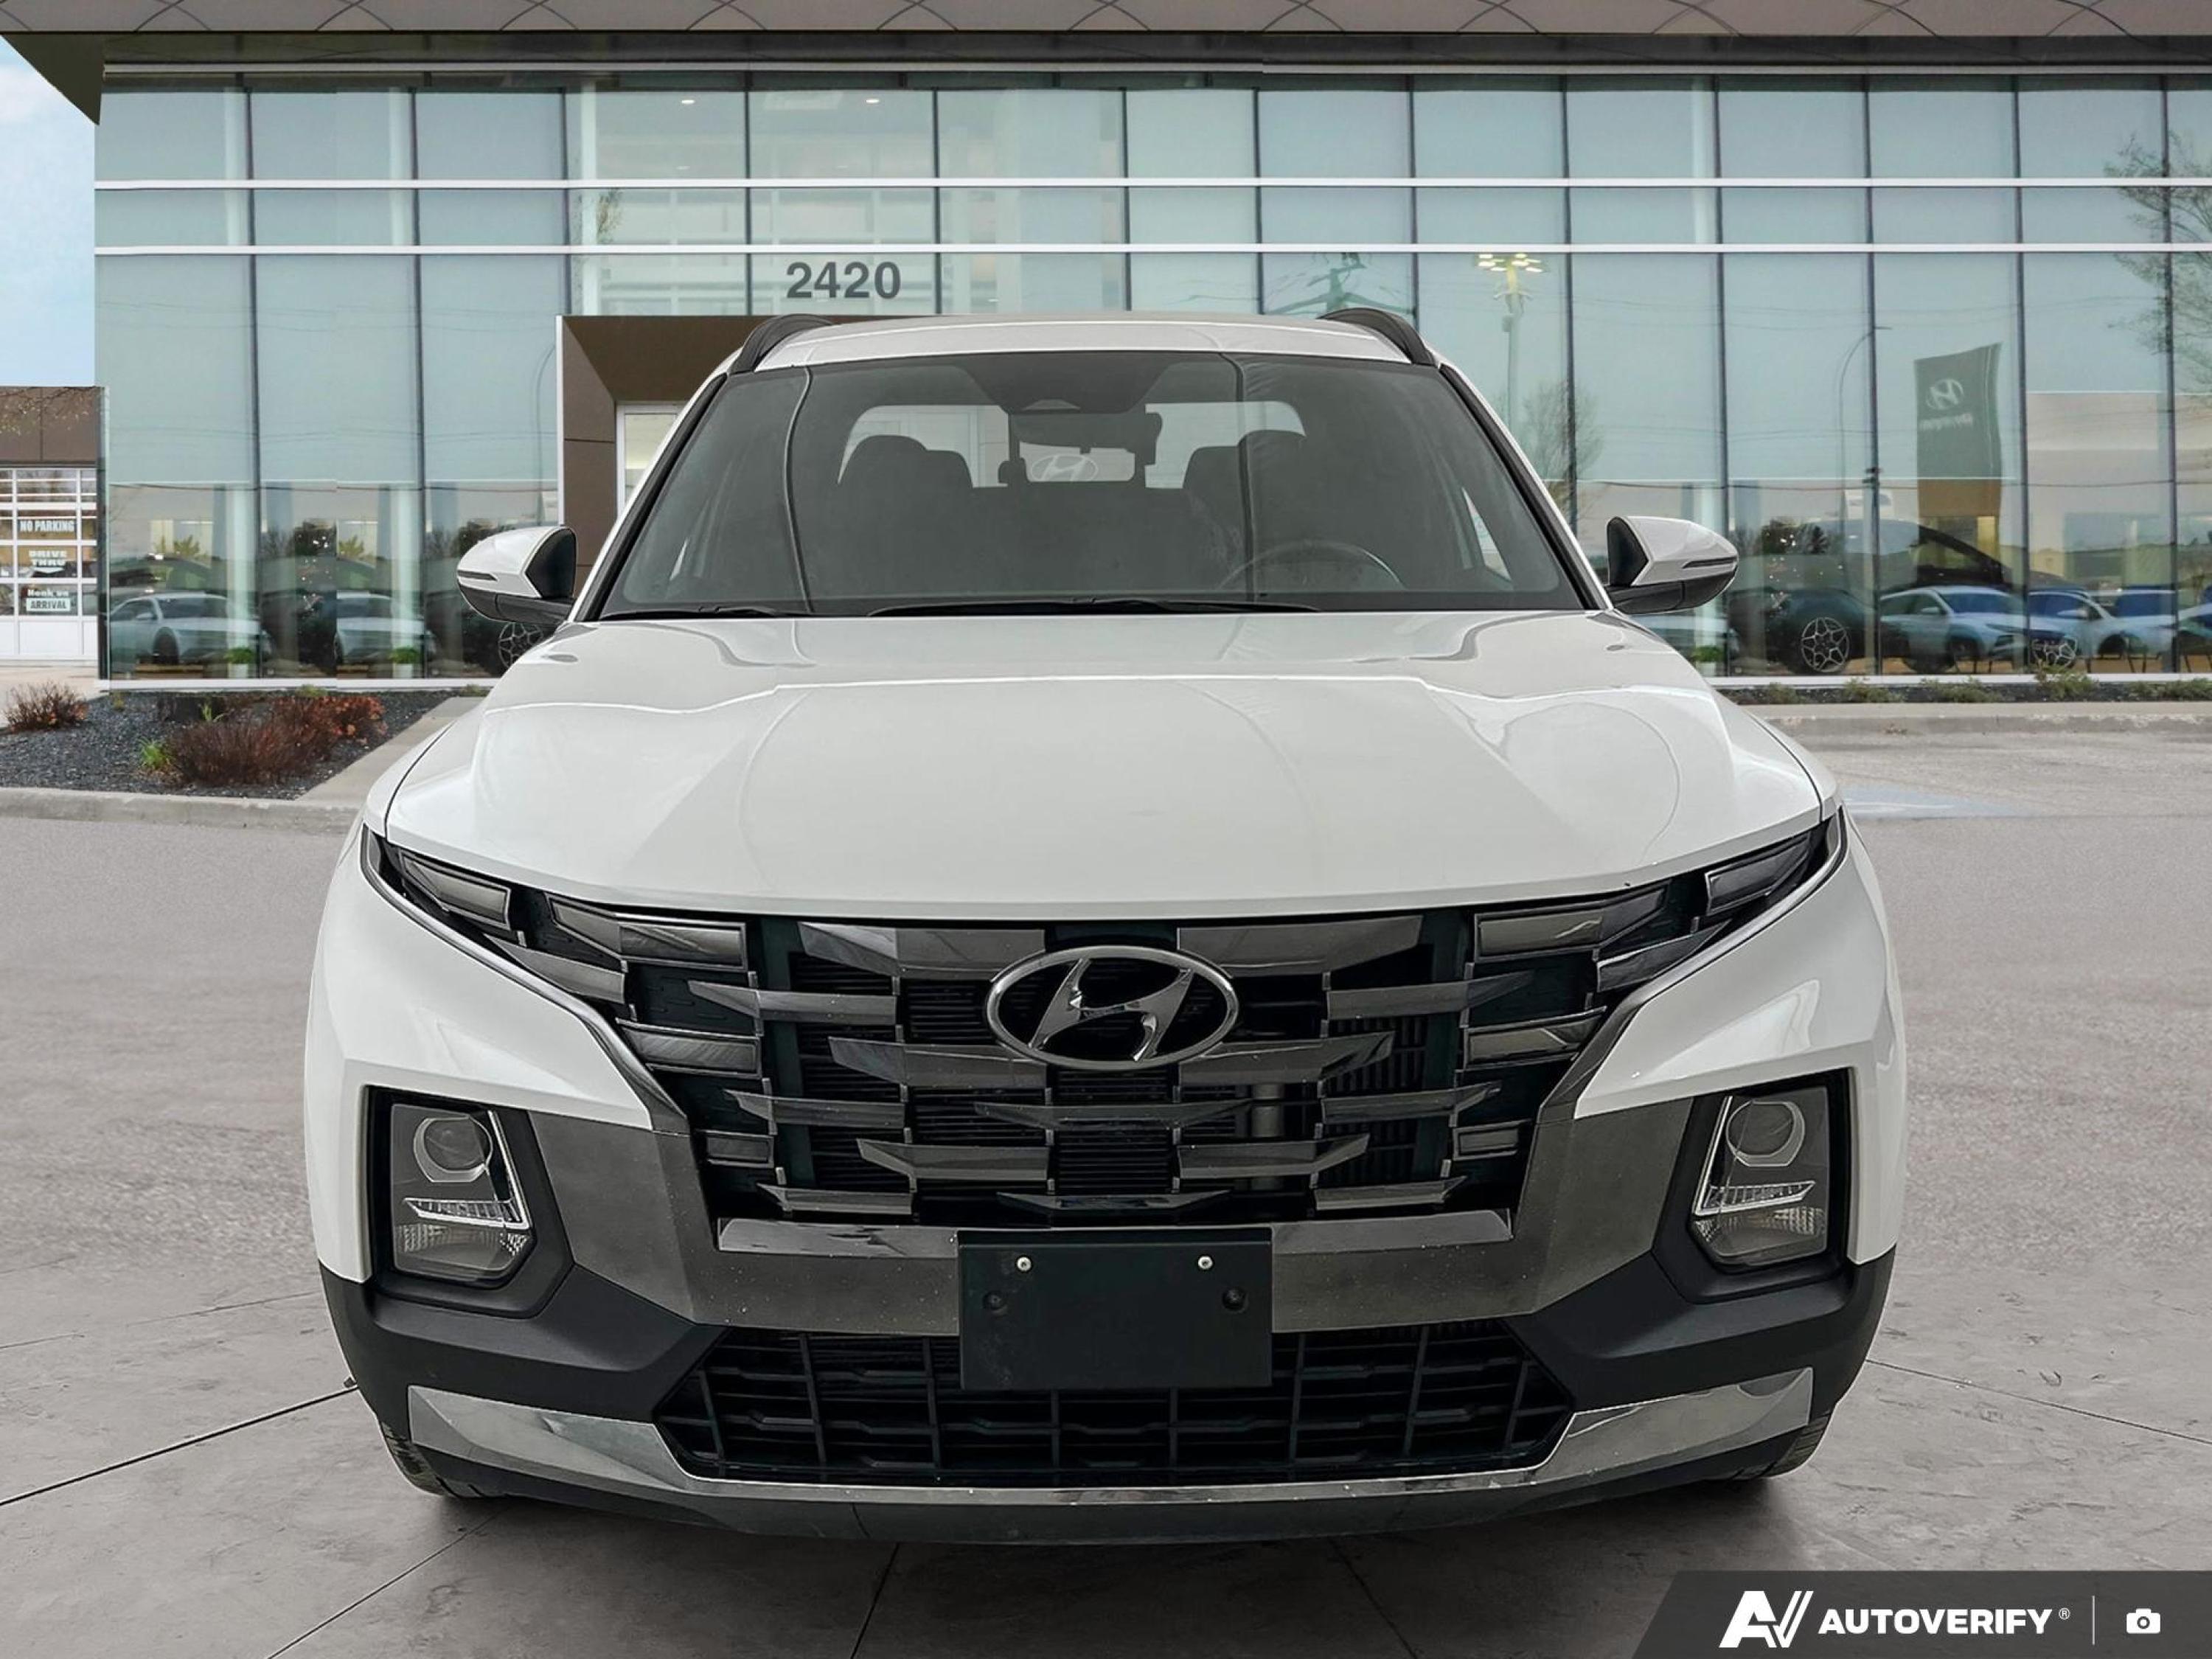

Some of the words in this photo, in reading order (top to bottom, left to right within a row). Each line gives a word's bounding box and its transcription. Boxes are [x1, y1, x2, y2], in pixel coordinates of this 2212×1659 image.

[786, 261, 901, 299] 2420
[20, 520, 33, 532] NO
[35, 520, 74, 532] PARKING
[29, 550, 67, 558] DRIVE
[32, 558, 66, 566] THRU
[30, 600, 67, 609] ARRIVAL
